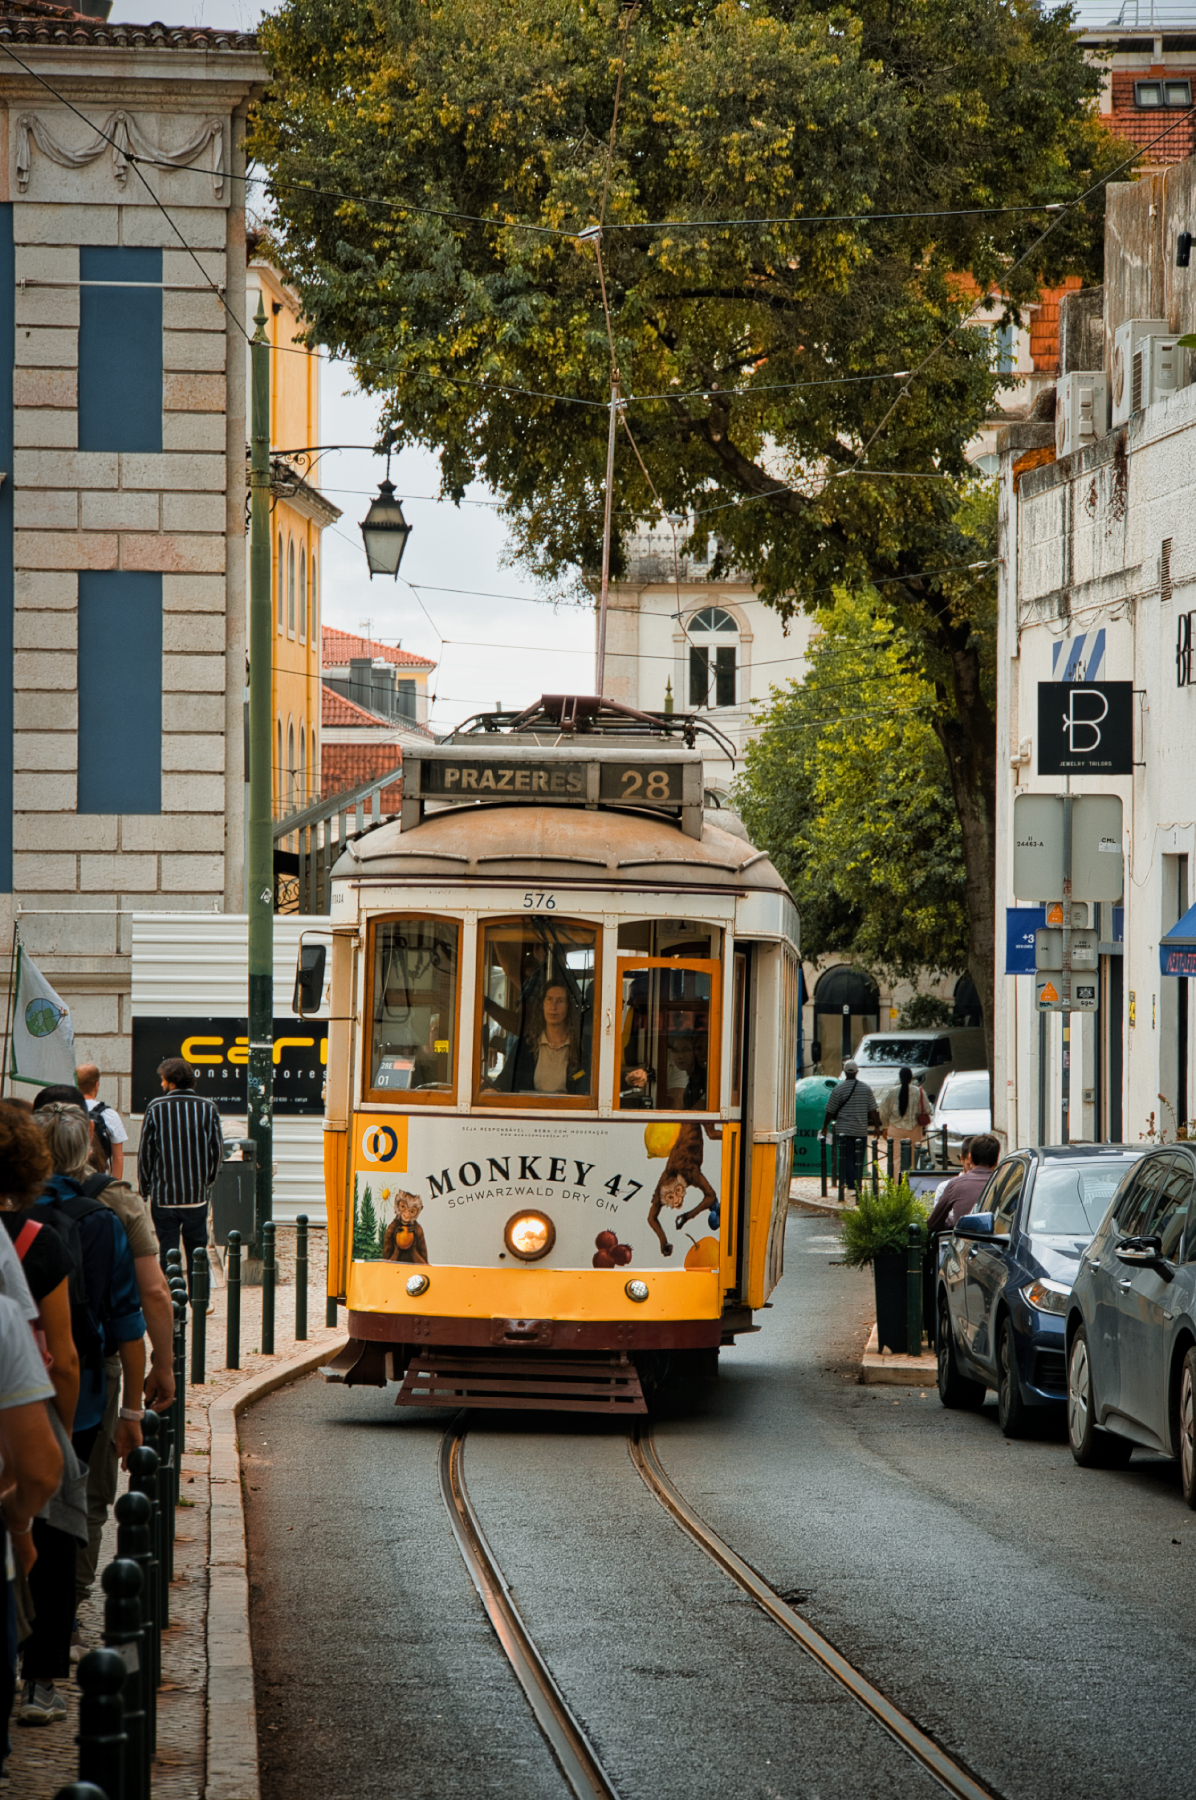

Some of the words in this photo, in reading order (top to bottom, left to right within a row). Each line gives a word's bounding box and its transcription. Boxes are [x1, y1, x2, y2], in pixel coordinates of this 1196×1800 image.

[444, 768, 582, 793] PRAZERES
[620, 769, 671, 801] 28
[523, 893, 556, 909] 576
[380, 1062, 393, 1070] 28E
[377, 1075, 389, 1086] 01
[425, 1155, 596, 1200] MONKEY
[603, 1173, 644, 1202] 47
[448, 1186, 554, 1208] SCHWARZWALD
[561, 1189, 590, 1203] DRY
[595, 1198, 619, 1213] GIN
